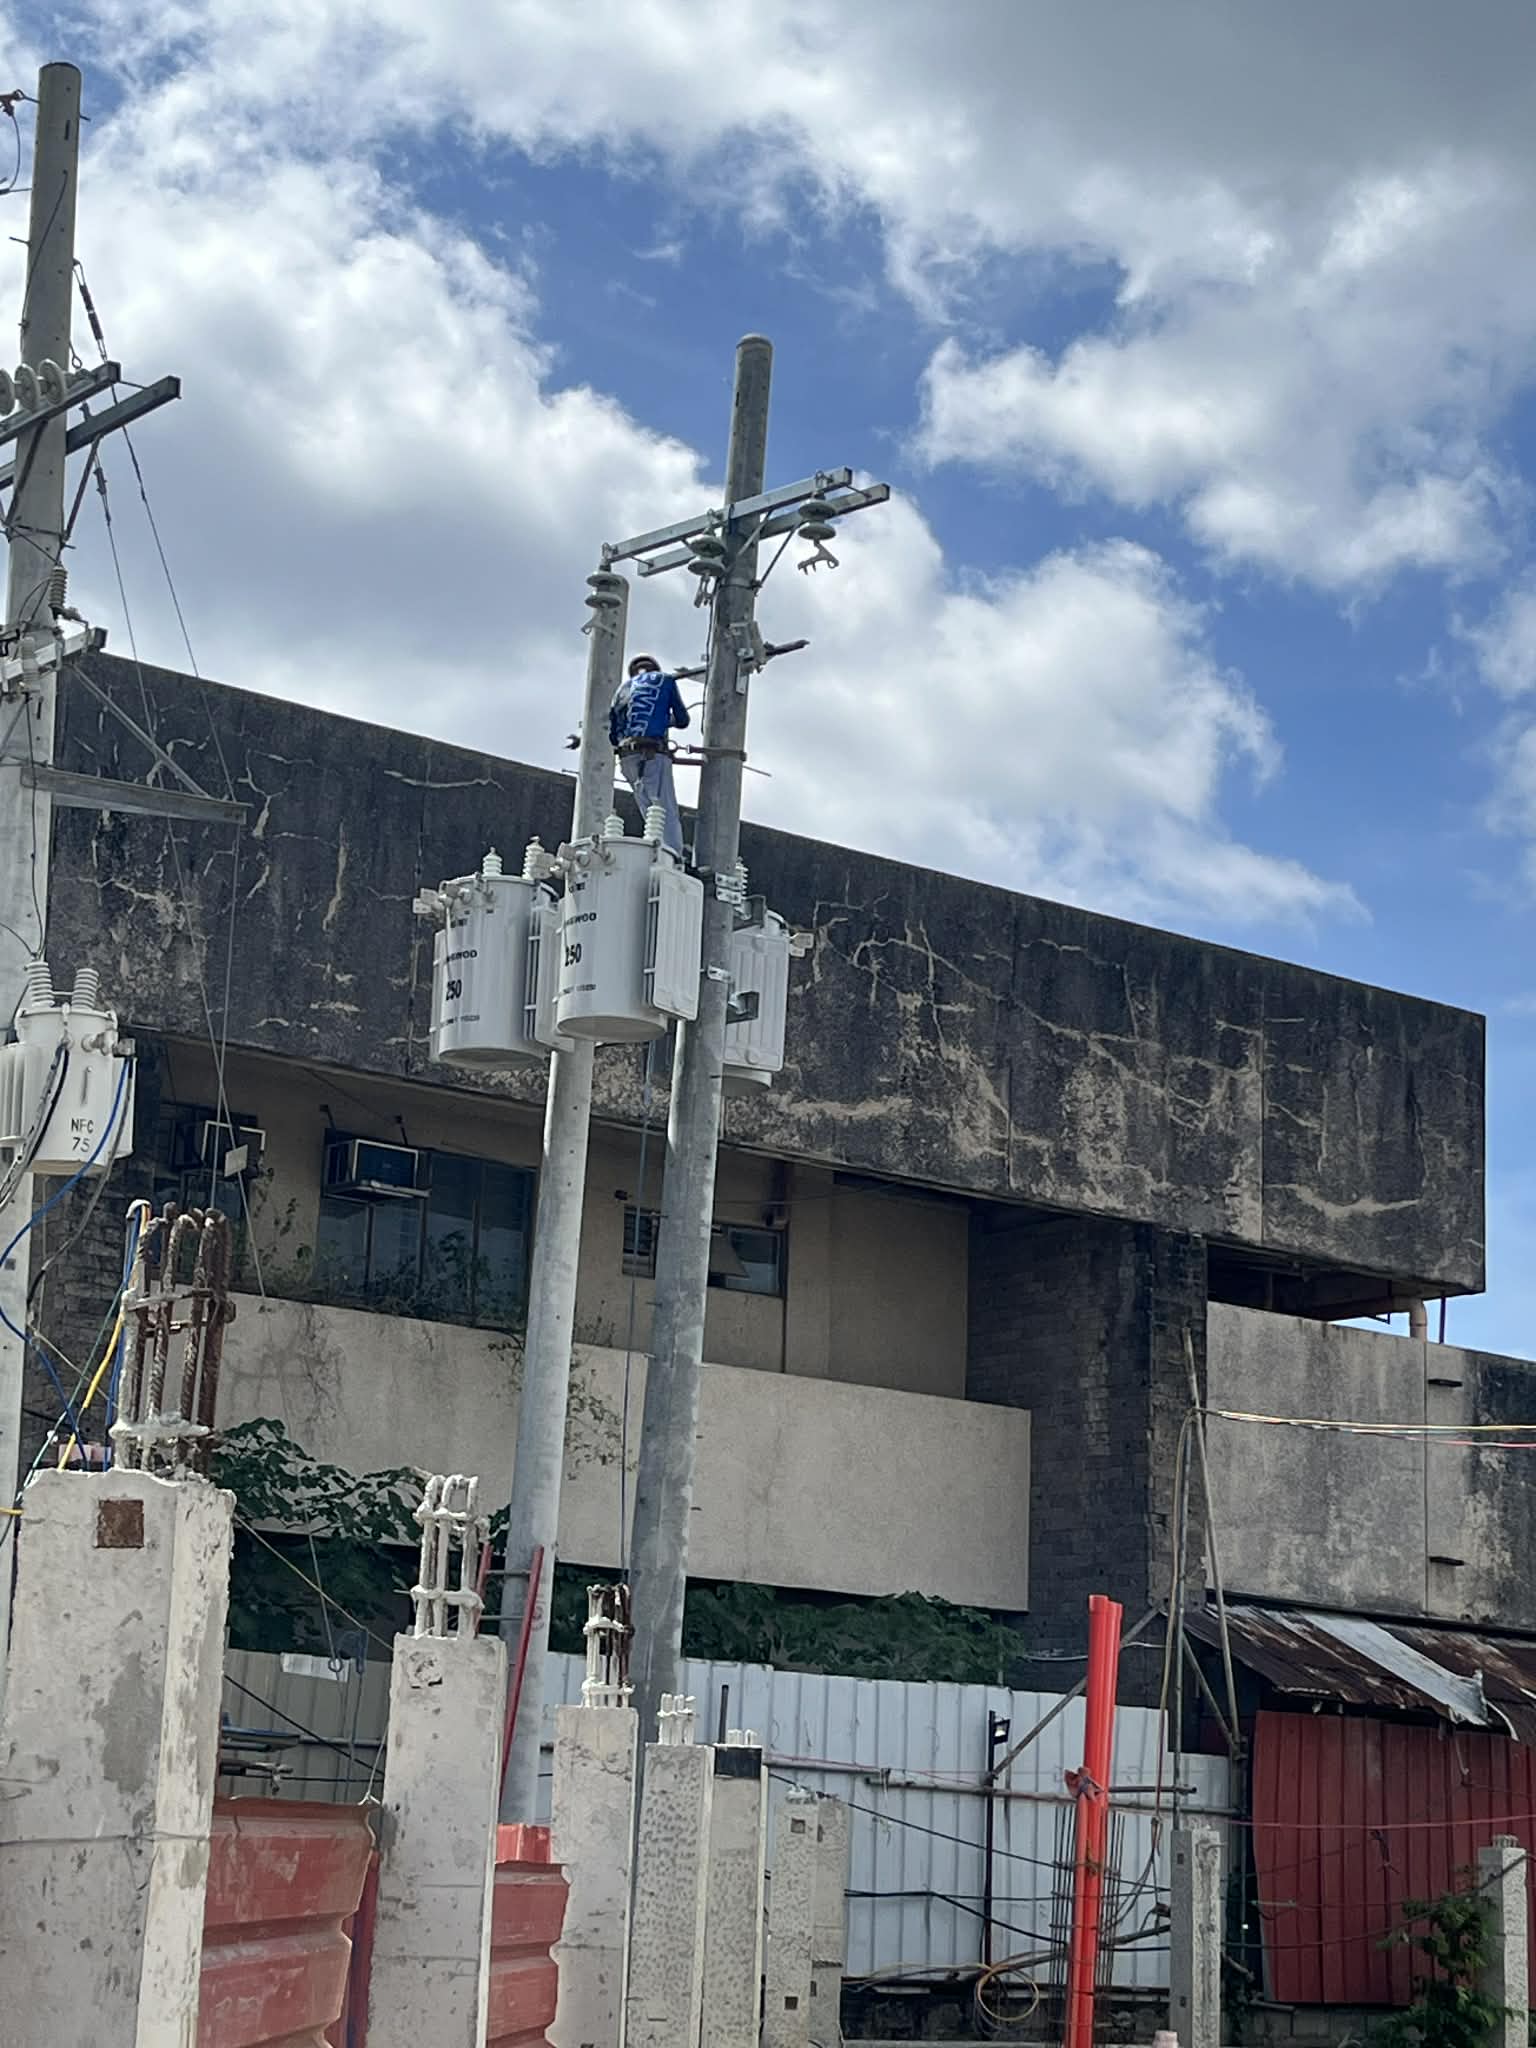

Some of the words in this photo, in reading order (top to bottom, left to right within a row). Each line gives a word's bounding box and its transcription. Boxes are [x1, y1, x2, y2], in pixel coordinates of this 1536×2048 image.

[446, 979, 462, 1001] 250
[71, 1118, 94, 1133] NFC
[72, 1136, 90, 1152] 75
